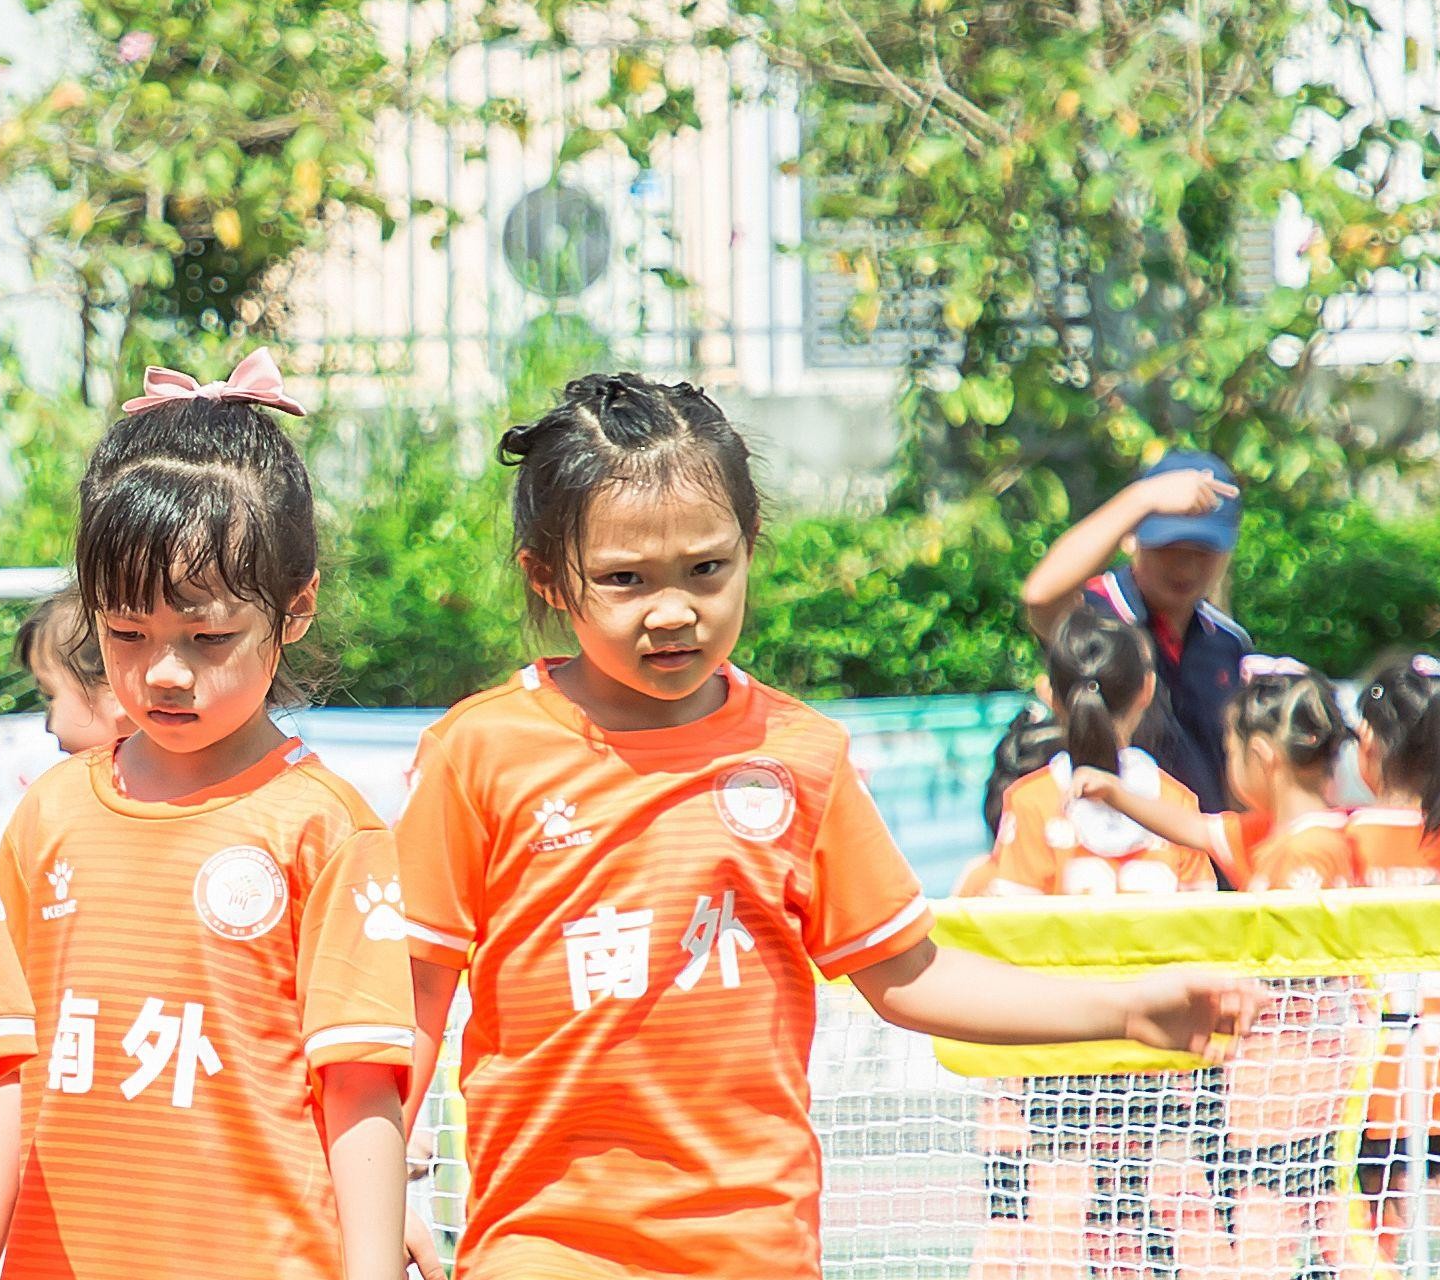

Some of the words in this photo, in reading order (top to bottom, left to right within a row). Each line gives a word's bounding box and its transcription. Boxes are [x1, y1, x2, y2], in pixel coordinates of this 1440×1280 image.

[528, 830, 594, 852] KELME
[562, 890, 755, 1011] 南外
[47, 989, 224, 1108] 南外
